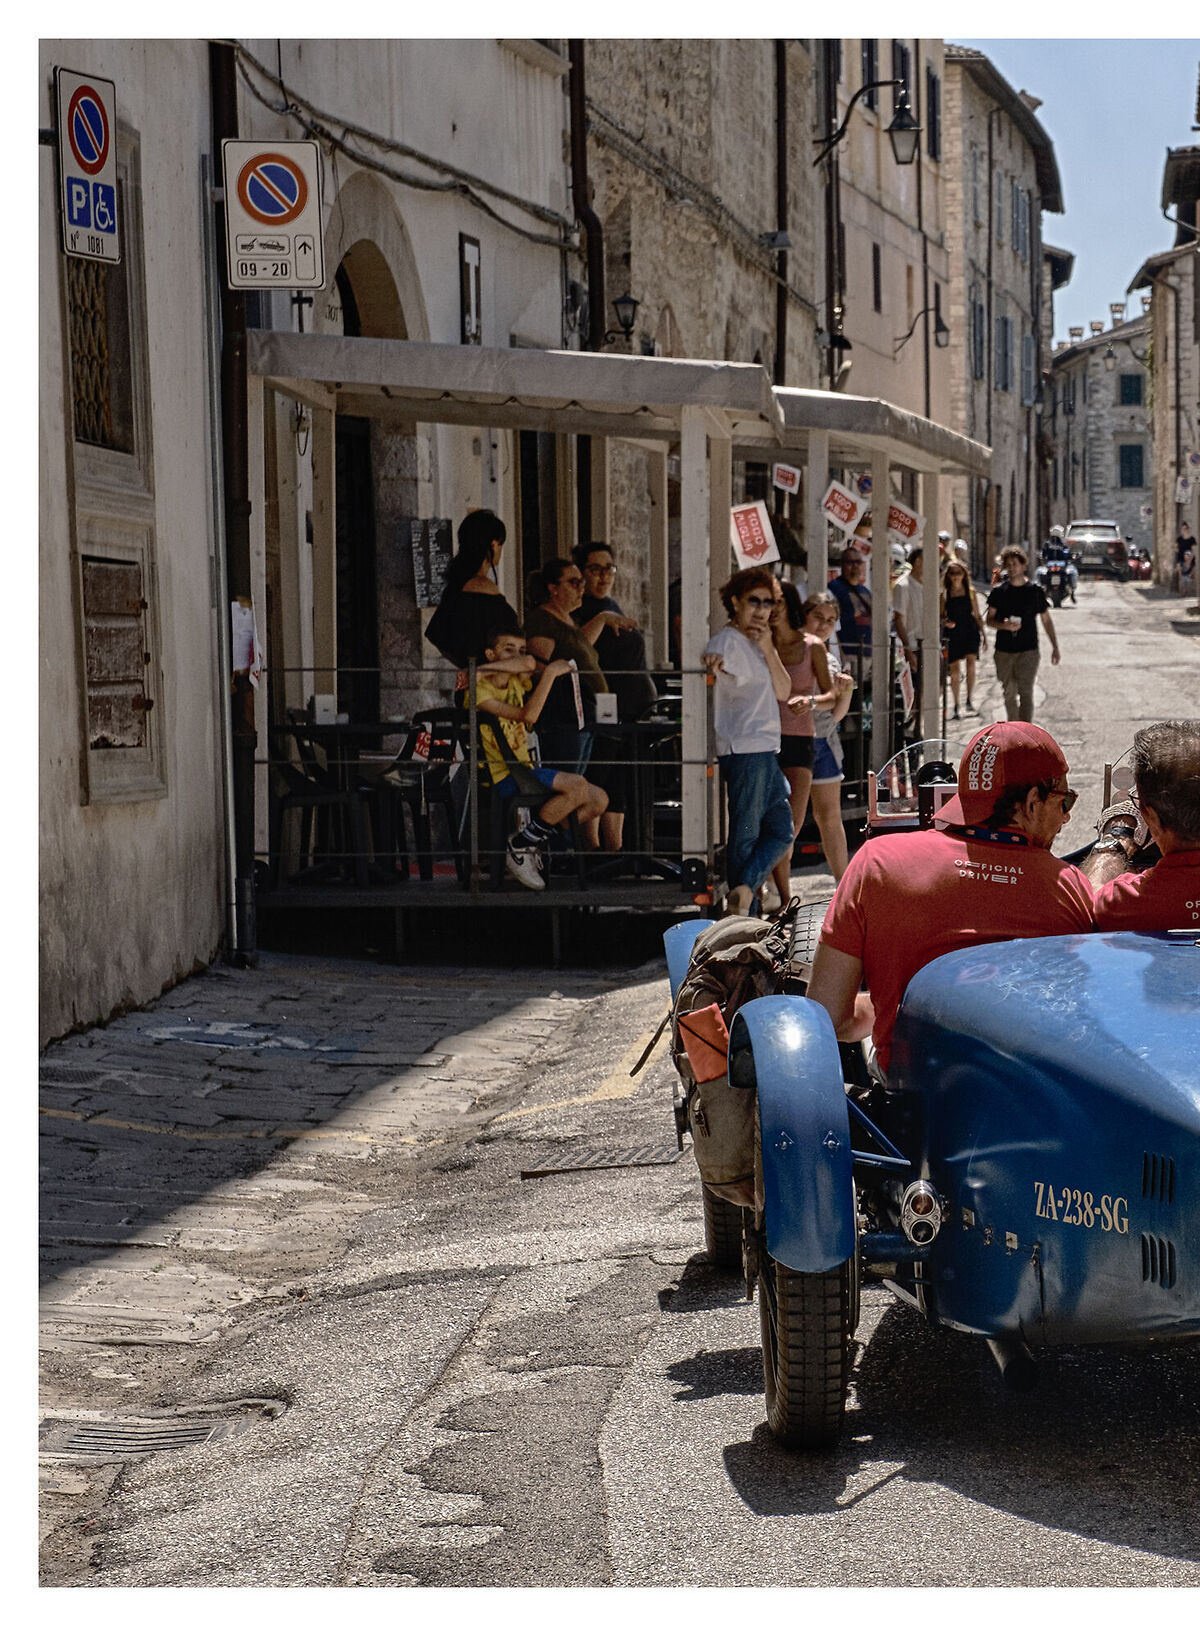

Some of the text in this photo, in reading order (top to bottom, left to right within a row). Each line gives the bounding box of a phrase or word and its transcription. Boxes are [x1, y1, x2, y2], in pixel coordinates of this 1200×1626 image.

[87, 235, 104, 255] 1081
[240, 262, 257, 276] 09
[272, 262, 288, 276] 20
[968, 735, 993, 790] BRESCIA
[982, 745, 1000, 791] CORSE
[954, 859, 1024, 875] OFFICIAL
[960, 869, 1017, 885] DRIVER
[1034, 1181, 1129, 1234] ZA-238-SG
